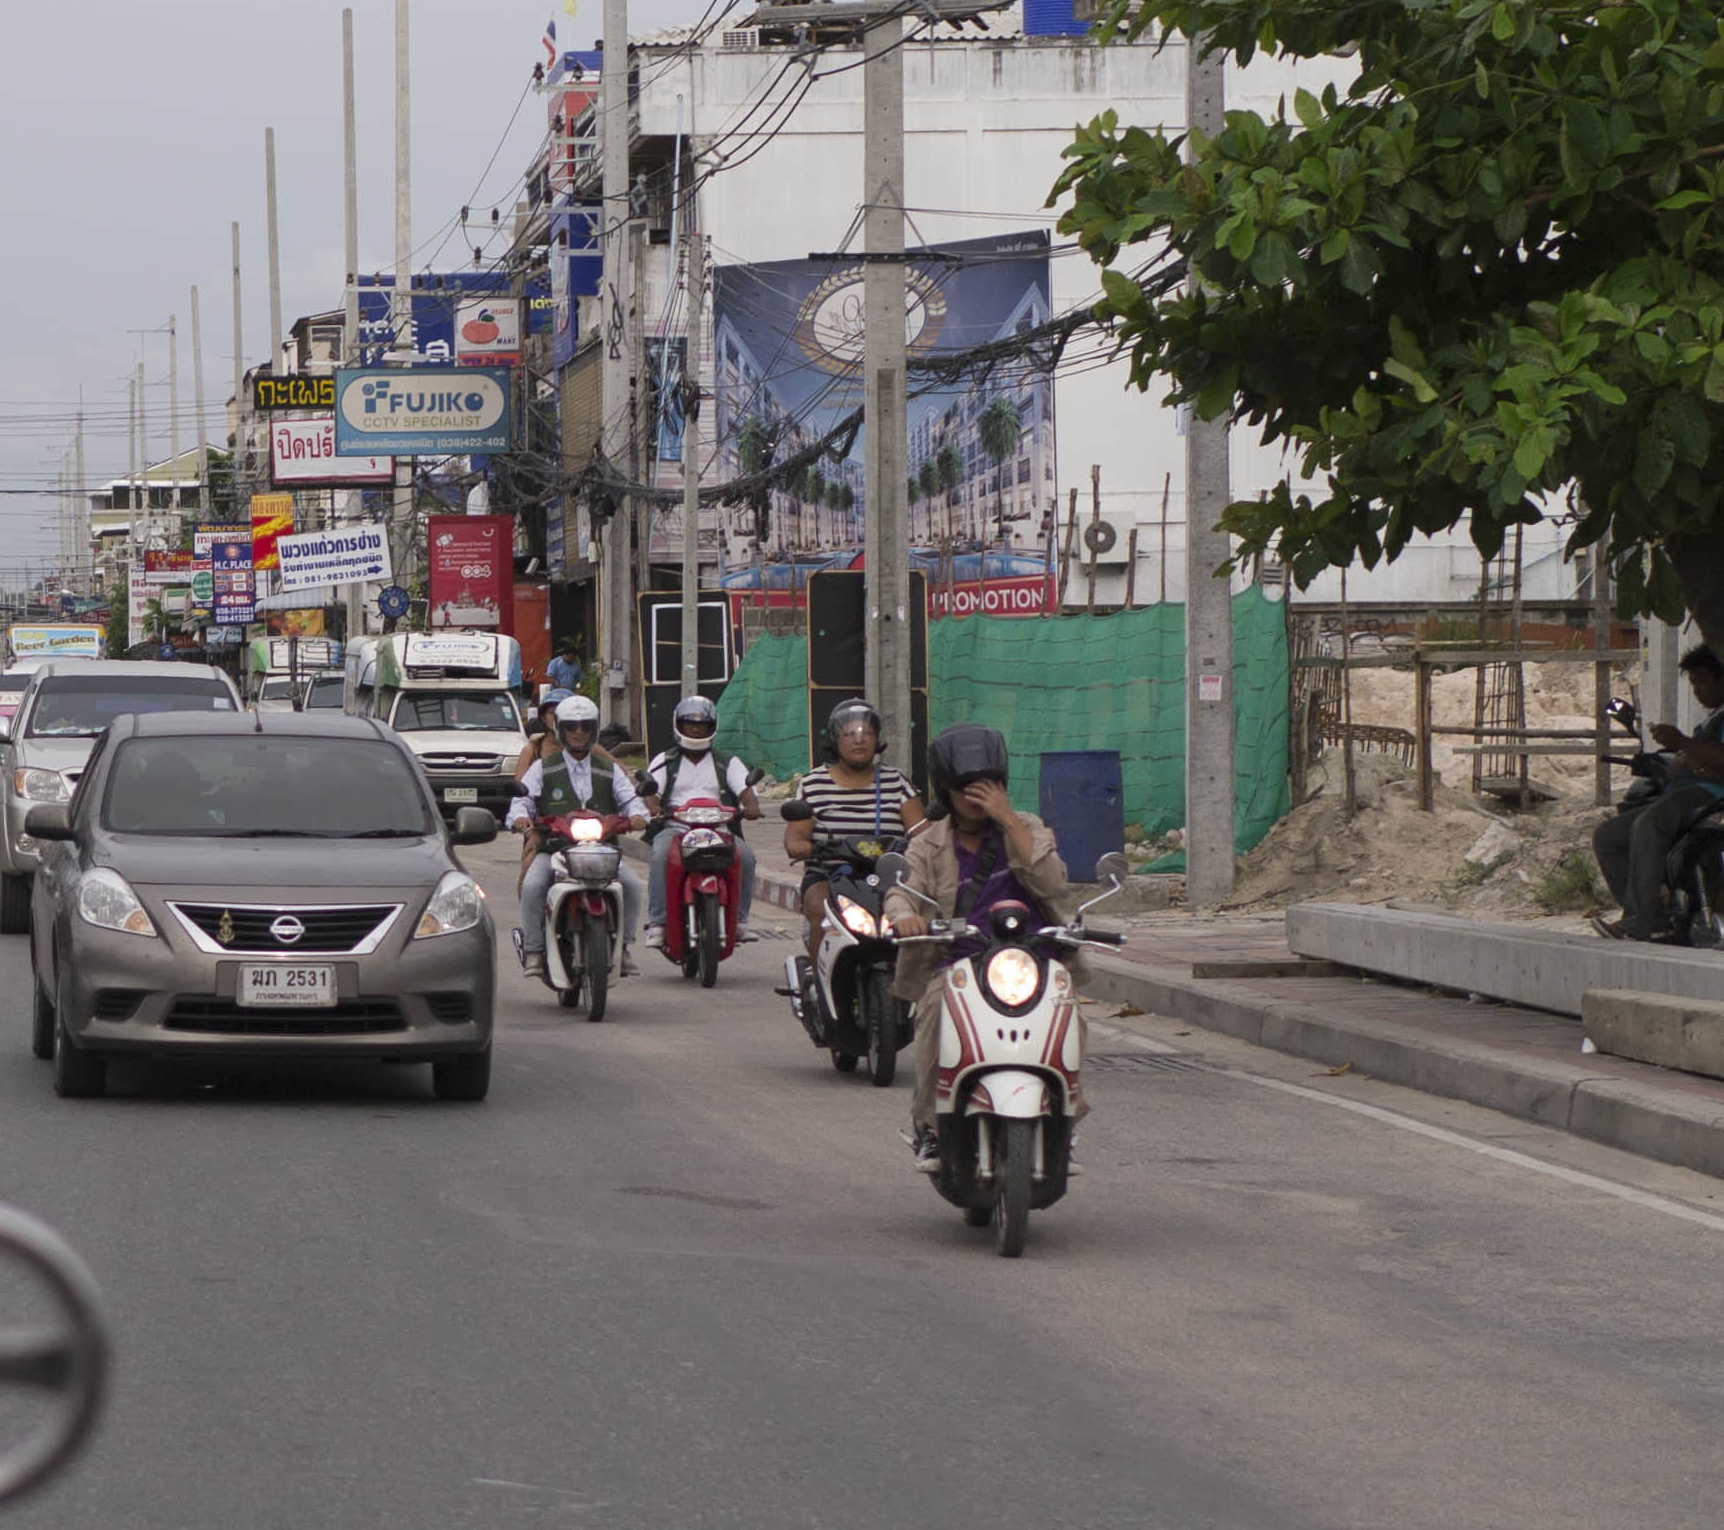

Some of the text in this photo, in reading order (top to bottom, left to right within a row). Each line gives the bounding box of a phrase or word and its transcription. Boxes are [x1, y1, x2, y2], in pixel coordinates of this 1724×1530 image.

[389, 391, 485, 413] FUJIKO
[363, 415, 482, 429] CCTV SPECIALIST
[932, 587, 1045, 612] PROMOTION
[286, 970, 327, 987] 2531
